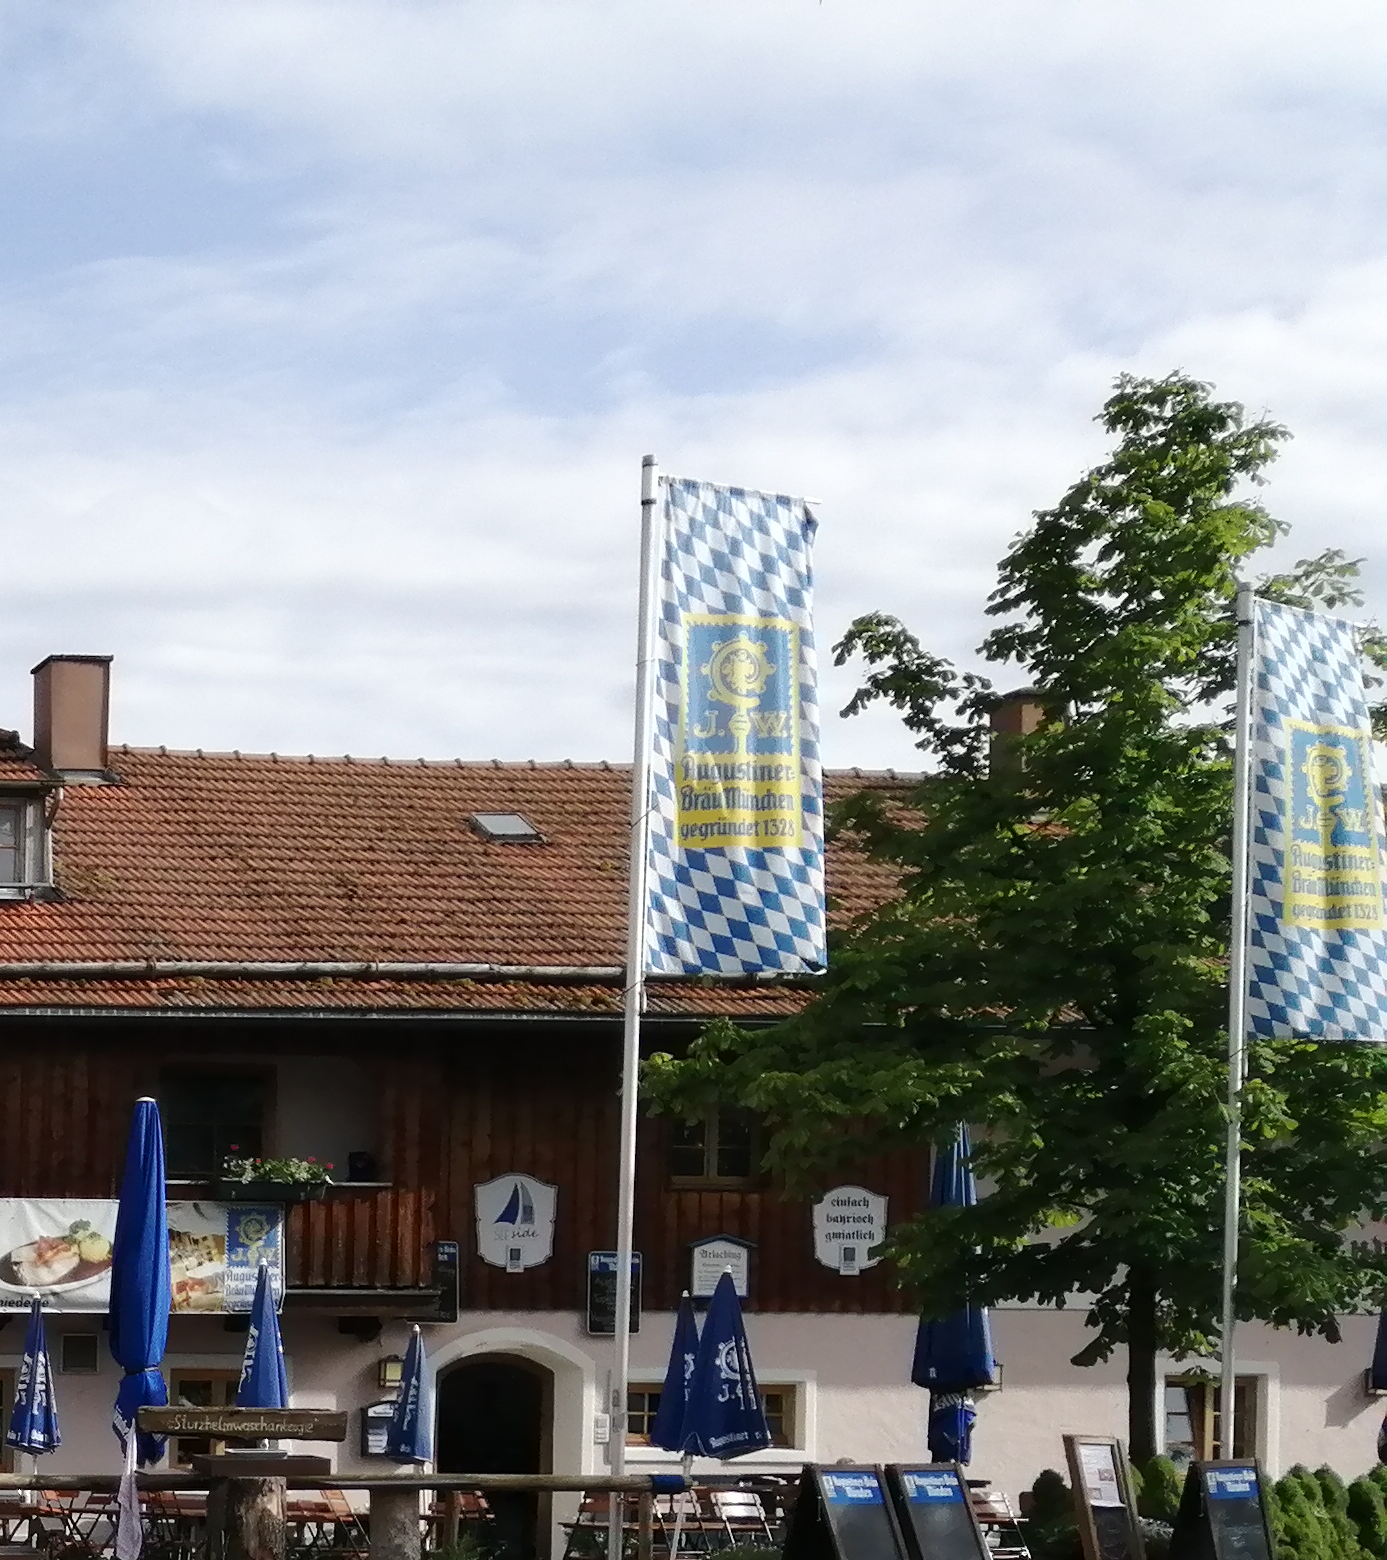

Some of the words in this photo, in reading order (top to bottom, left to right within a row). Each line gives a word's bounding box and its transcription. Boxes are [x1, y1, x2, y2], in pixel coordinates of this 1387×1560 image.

[680, 784, 722, 812] Bräu
[723, 786, 794, 811] München
[680, 816, 759, 841] gegründet
[763, 818, 795, 837] 1328
[831, 1196, 870, 1209] einfach
